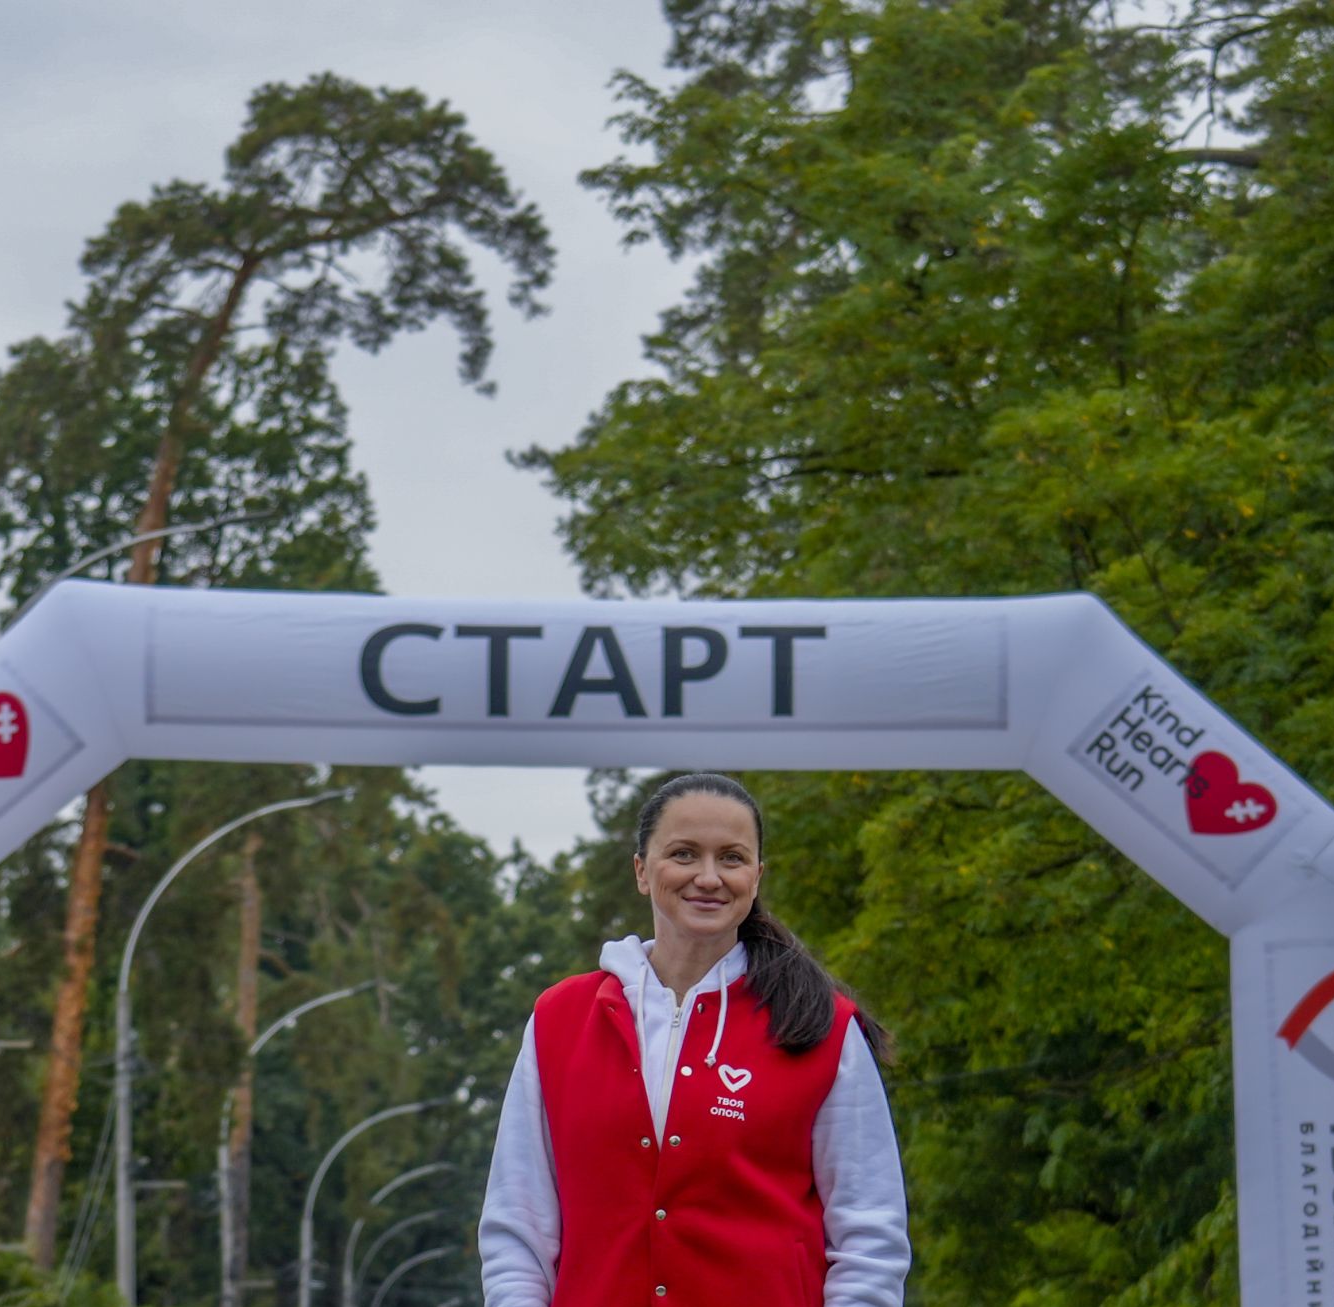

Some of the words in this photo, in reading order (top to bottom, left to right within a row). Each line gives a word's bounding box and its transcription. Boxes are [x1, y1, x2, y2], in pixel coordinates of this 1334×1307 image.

[358, 622, 827, 719] СТАРТ
[1132, 685, 1206, 748] Kind
[1085, 730, 1145, 792] Run
[1108, 706, 1210, 799] Hearts
[710, 1106, 745, 1121] ОПОРА
[717, 1096, 744, 1109] ТВОЯ
